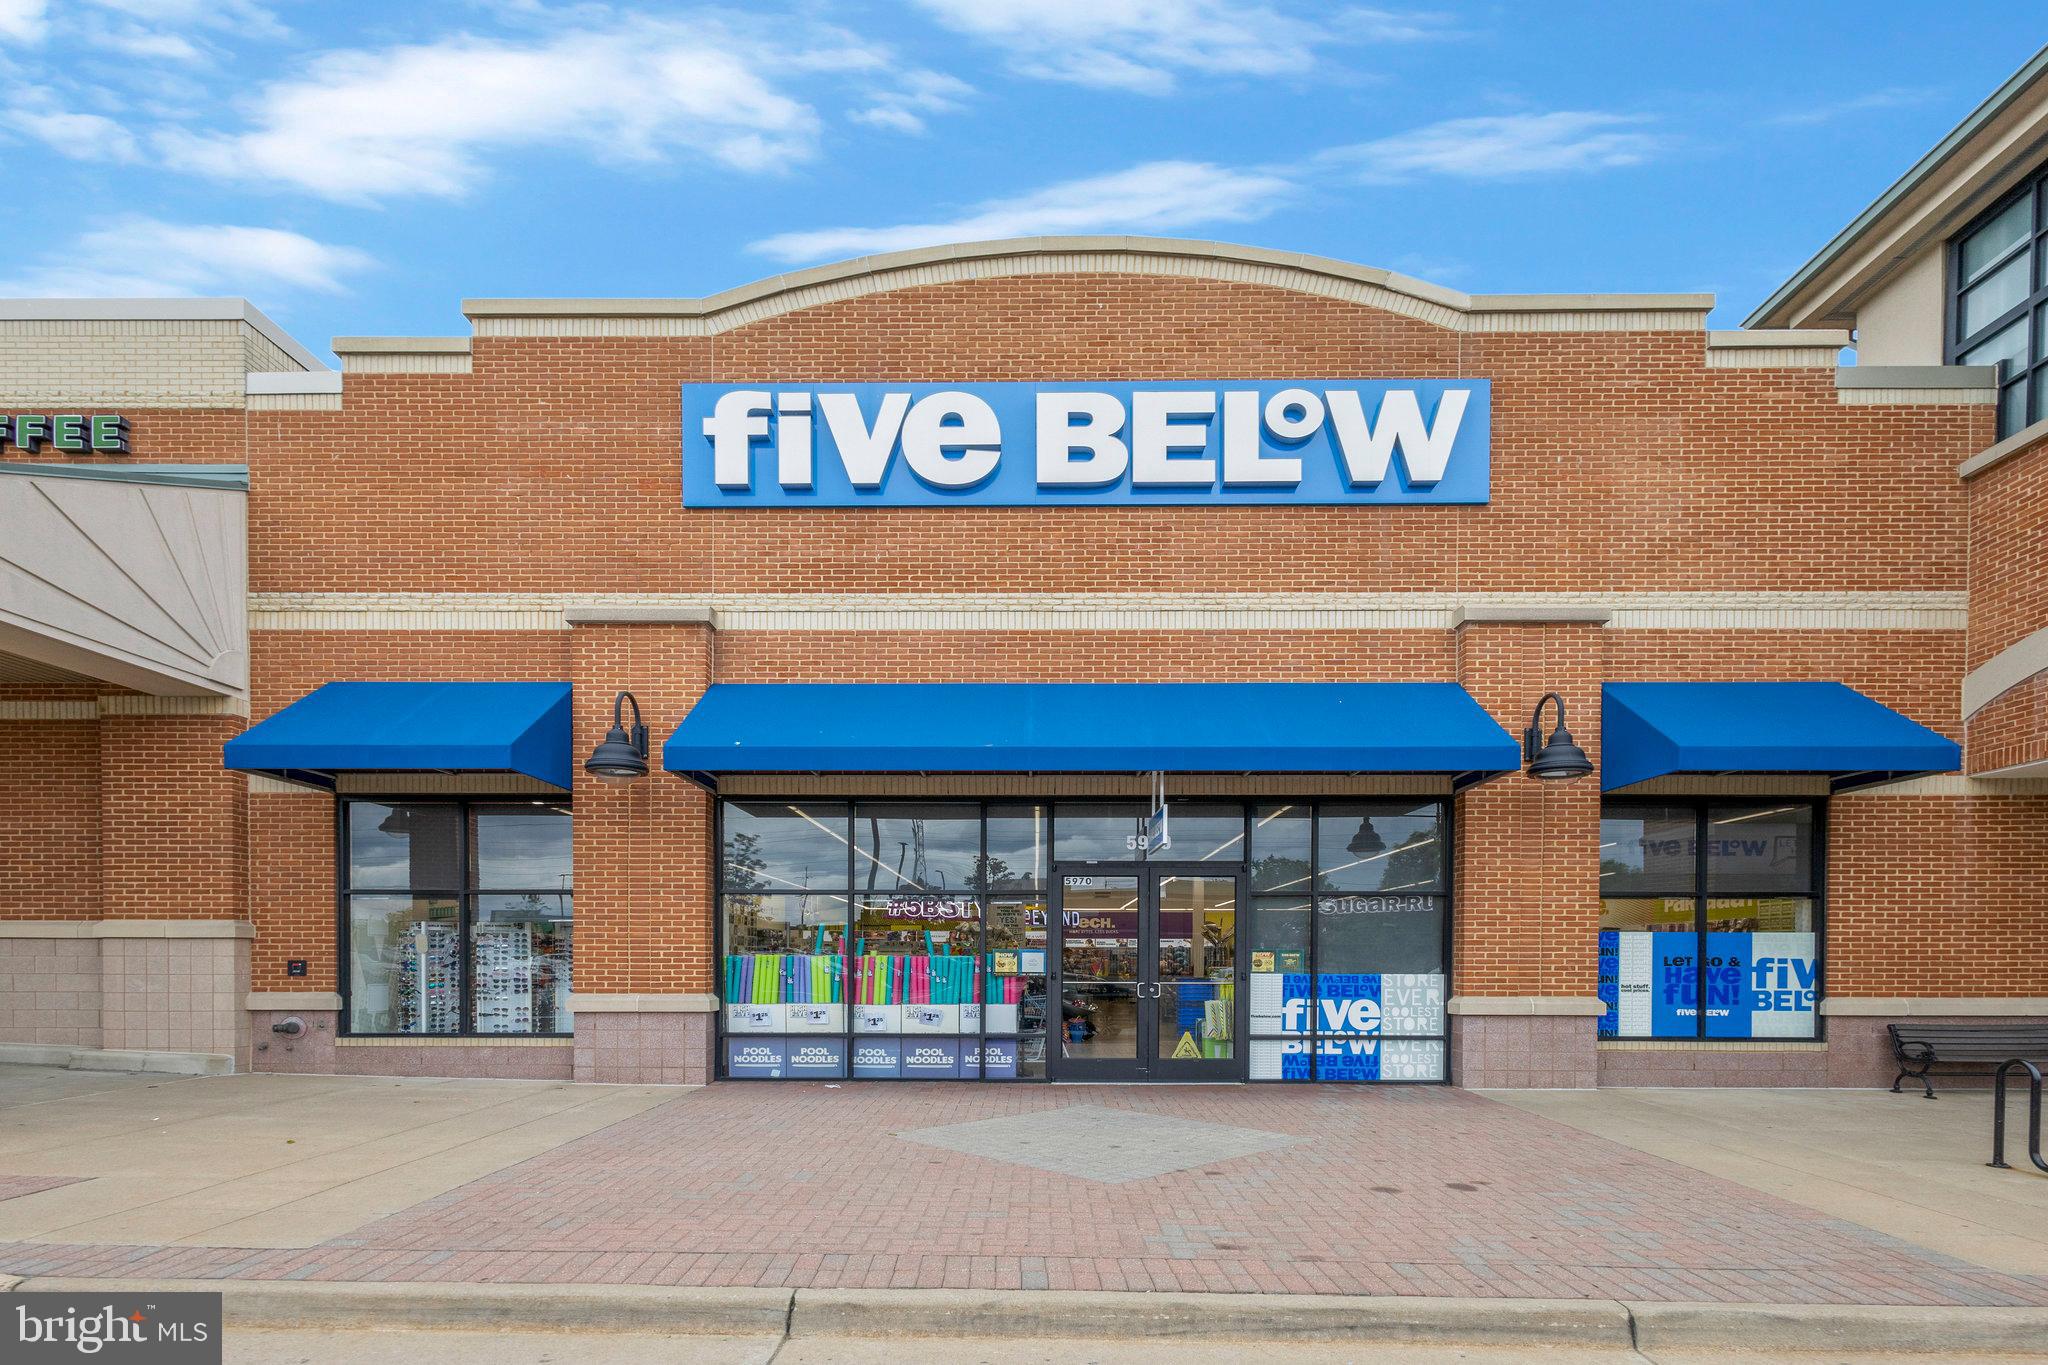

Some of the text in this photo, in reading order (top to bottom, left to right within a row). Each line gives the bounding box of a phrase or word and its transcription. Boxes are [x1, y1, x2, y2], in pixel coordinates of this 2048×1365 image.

[703, 388, 1471, 490] five BELOW
[1065, 877, 1092, 885] 5970
[1705, 956, 1723, 967] O
[1382, 974, 1439, 987] STORE
[1383, 1006, 1440, 1018] COOLEST
[1705, 1008, 1730, 1016] ELOW
[1382, 1017, 1438, 1031] STORE
[1282, 1031, 1380, 1055] BELOW
[743, 1047, 772, 1055] POOL
[800, 1047, 829, 1055] POOL
[858, 1048, 887, 1056] POOL
[915, 1047, 944, 1056] POOL
[734, 1055, 782, 1063] NOODLES
[791, 1055, 839, 1063] NOODLES
[906, 1056, 953, 1064] NOODLES
[1382, 1053, 1440, 1064] COOLEST
[1382, 1064, 1438, 1078] STORE
